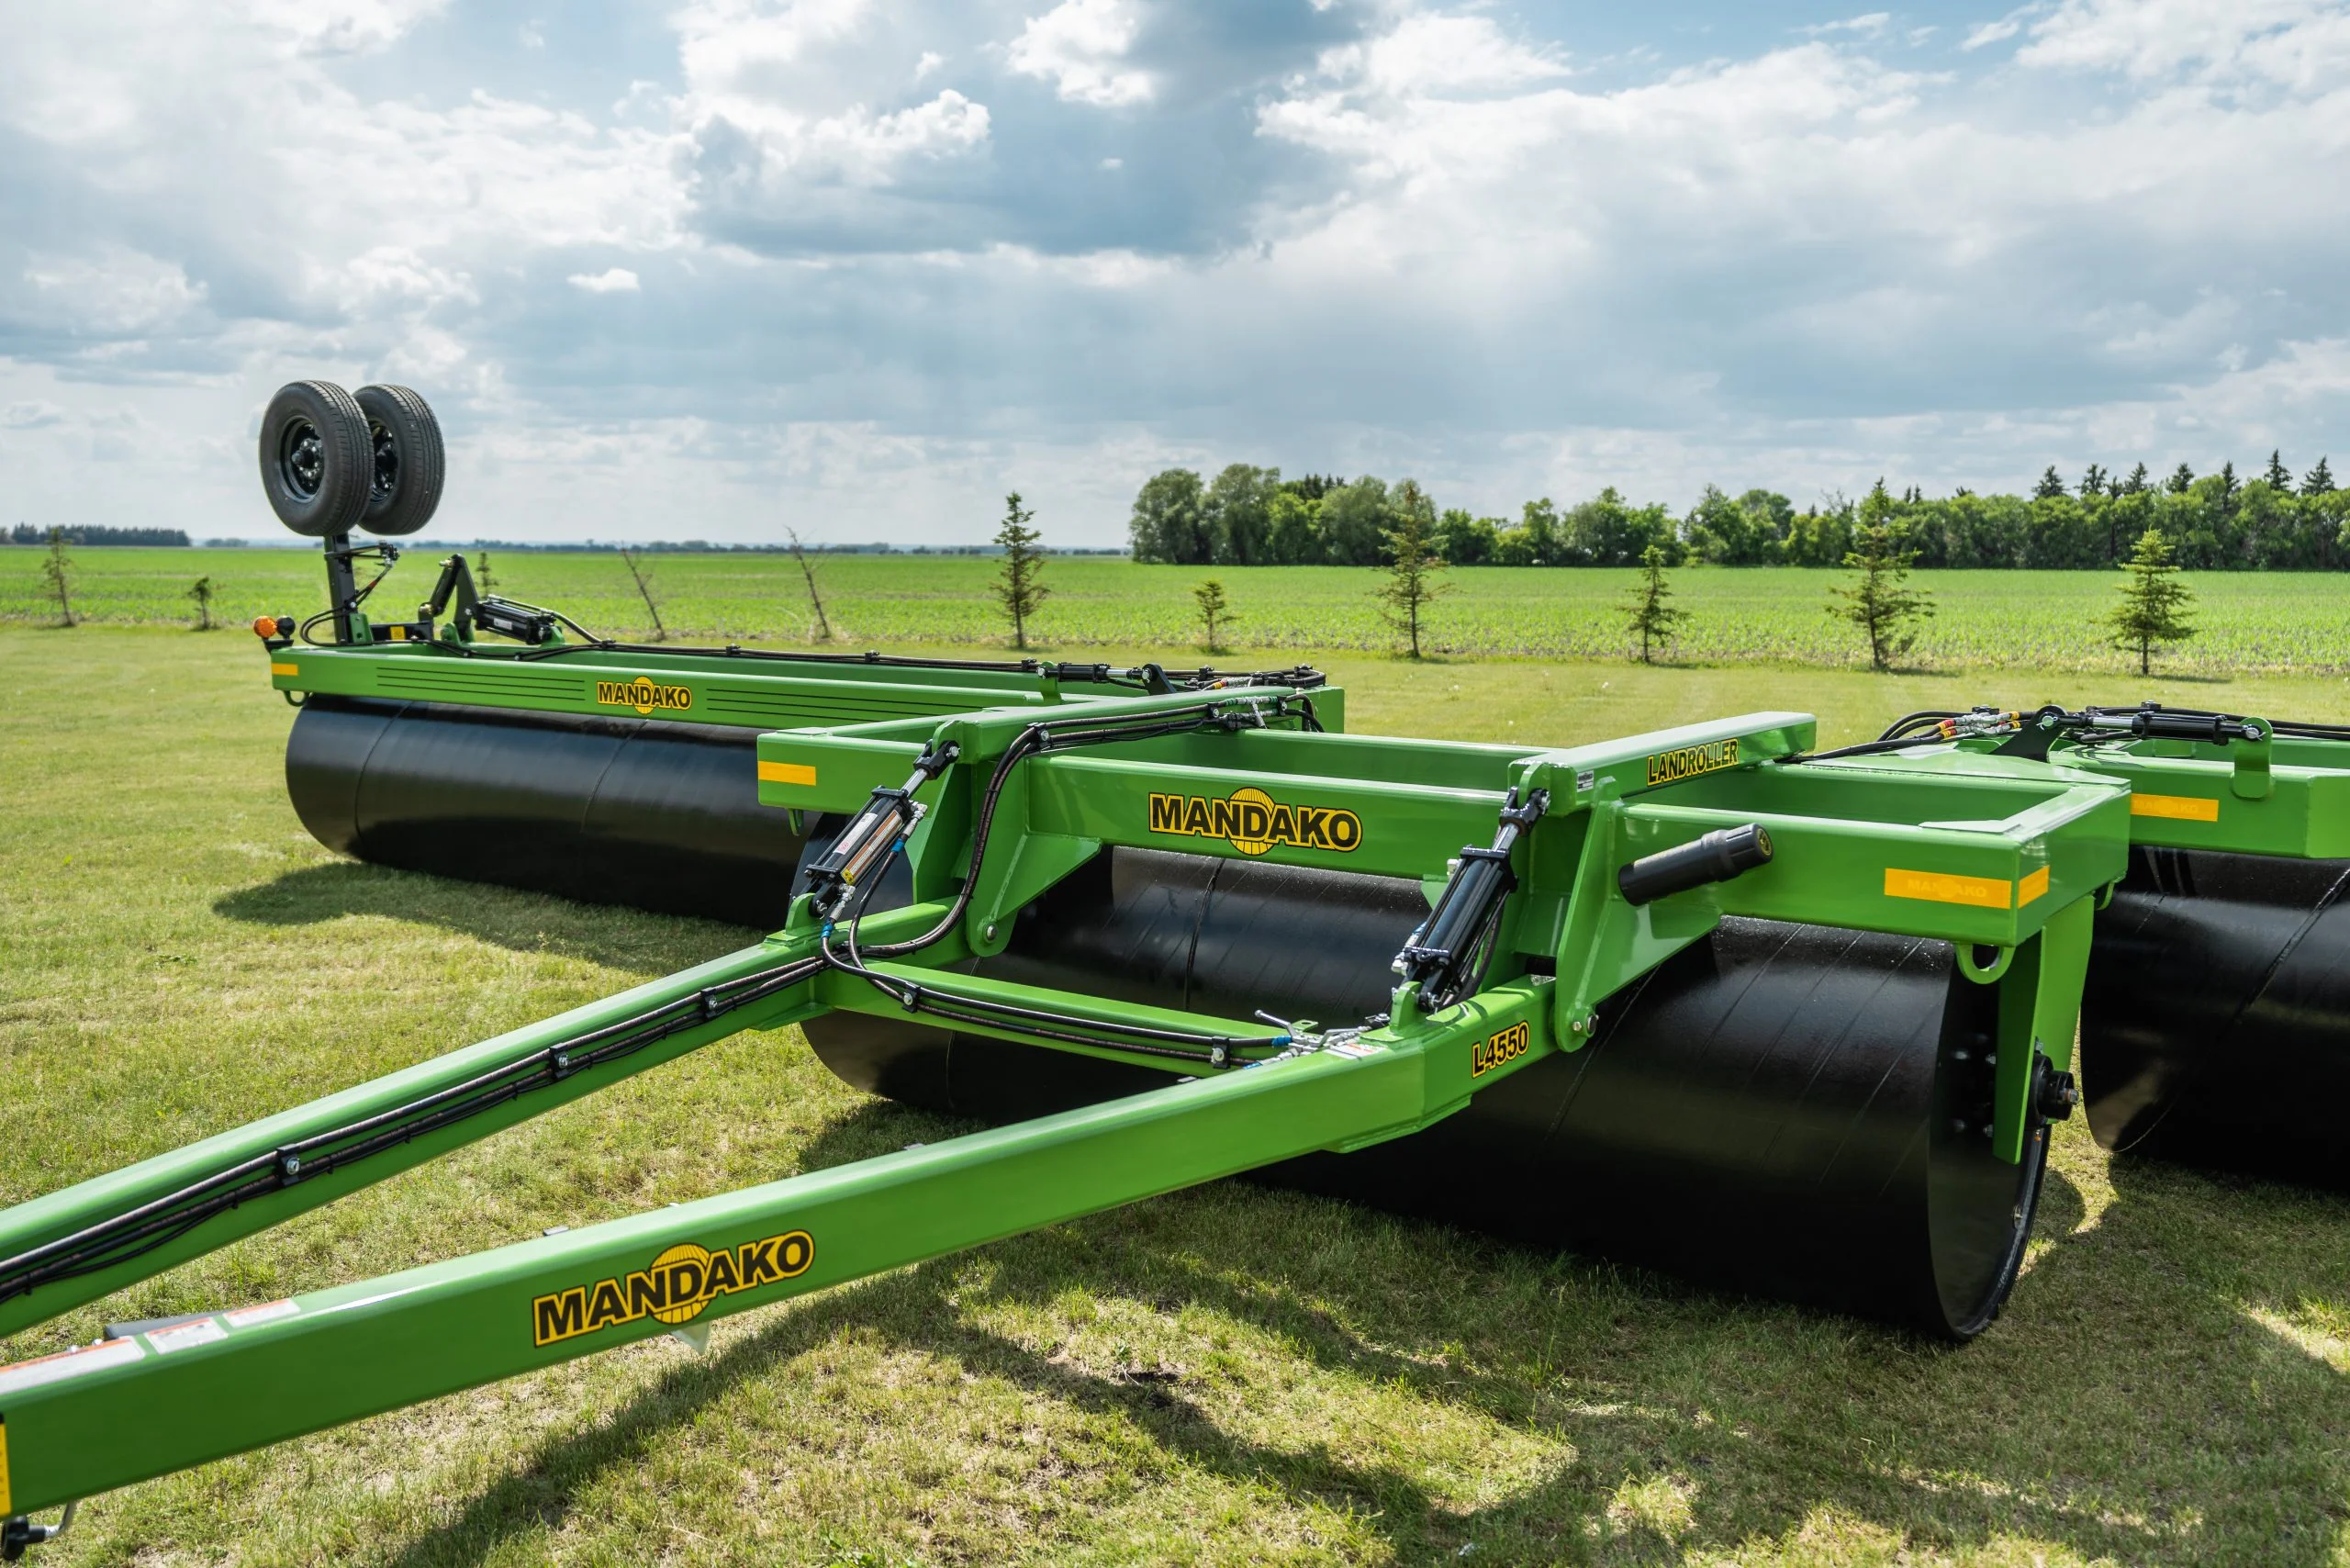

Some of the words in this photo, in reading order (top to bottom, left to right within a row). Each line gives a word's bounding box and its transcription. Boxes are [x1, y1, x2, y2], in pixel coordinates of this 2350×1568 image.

[598, 681, 691, 710] MANDAKO
[1648, 738, 1740, 786] LANDROLLER
[1149, 793, 1362, 851] MANDAKO
[1472, 1021, 1529, 1078] L4550
[533, 1230, 814, 1347] MANDAKO
